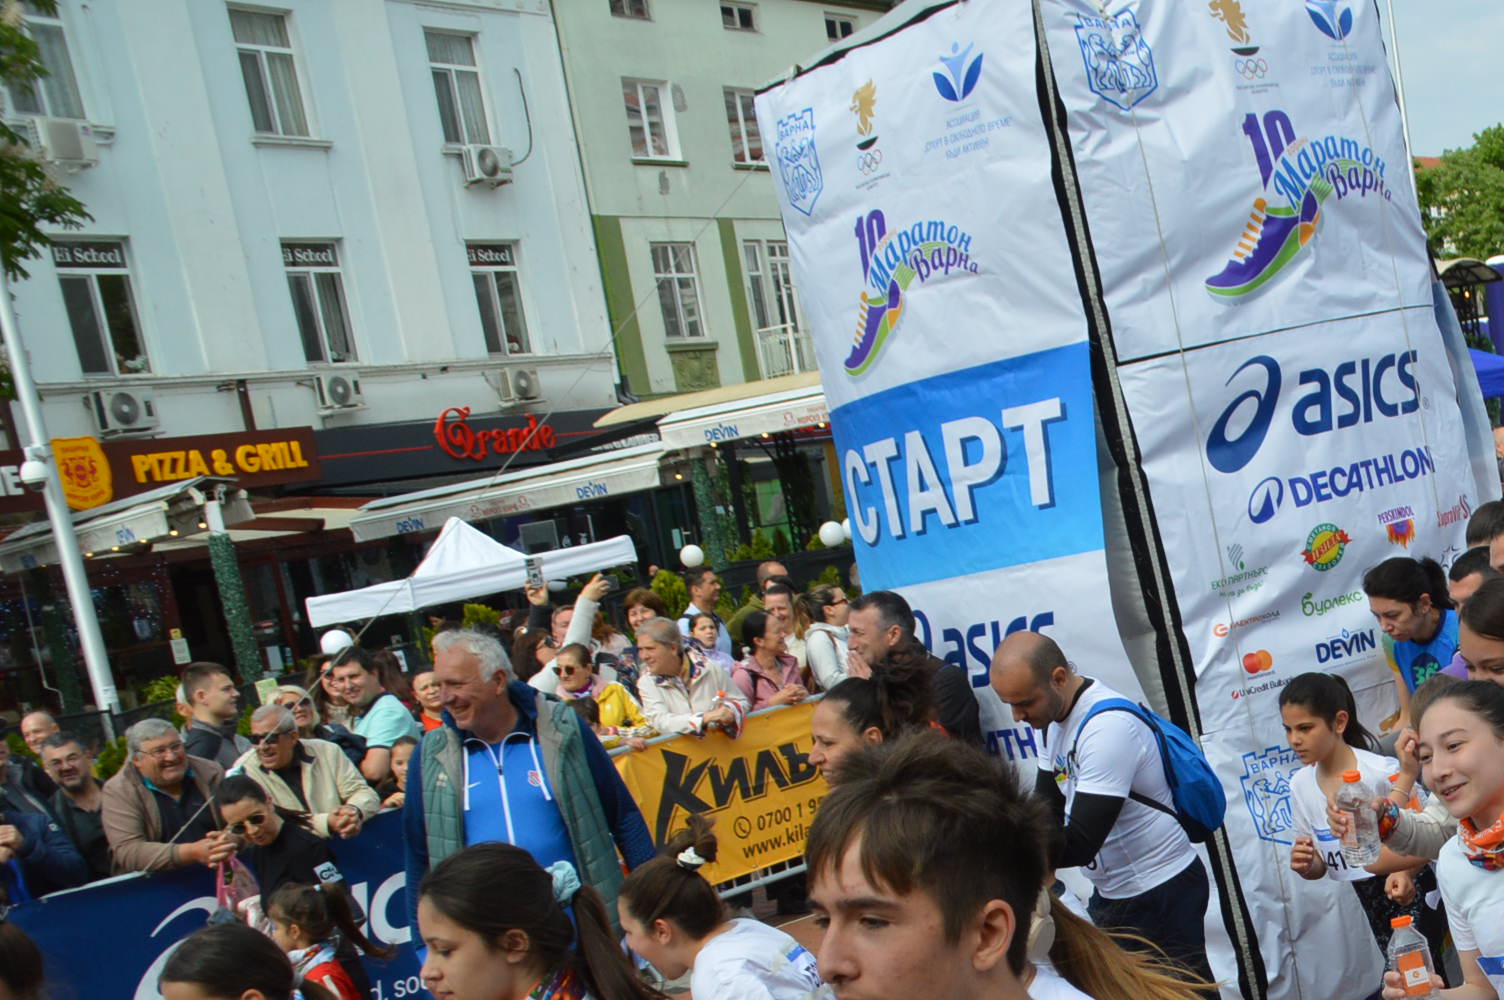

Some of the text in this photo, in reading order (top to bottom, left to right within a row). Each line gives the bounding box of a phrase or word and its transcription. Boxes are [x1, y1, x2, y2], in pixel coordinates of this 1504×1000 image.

[1242, 109, 1296, 190] 10
[1274, 136, 1386, 209] Маратон
[1326, 161, 1392, 201] Варна
[74, 246, 122, 264] School
[294, 249, 334, 263] School
[478, 248, 511, 262] School
[854, 209, 887, 284] 10
[869, 220, 972, 298] Маратон
[910, 245, 978, 283] Варна
[704, 424, 739, 442] DEVIN
[131, 440, 308, 483] PIZZA & GRILL
[845, 397, 1064, 547] СТАРТ
[1288, 445, 1436, 508] DECATHLON
[576, 481, 609, 499] DEVIN
[396, 516, 425, 534] DEVIN
[1315, 628, 1377, 664] DEVIN
[757, 807, 792, 831] 0700
[742, 826, 811, 859] www.kila
